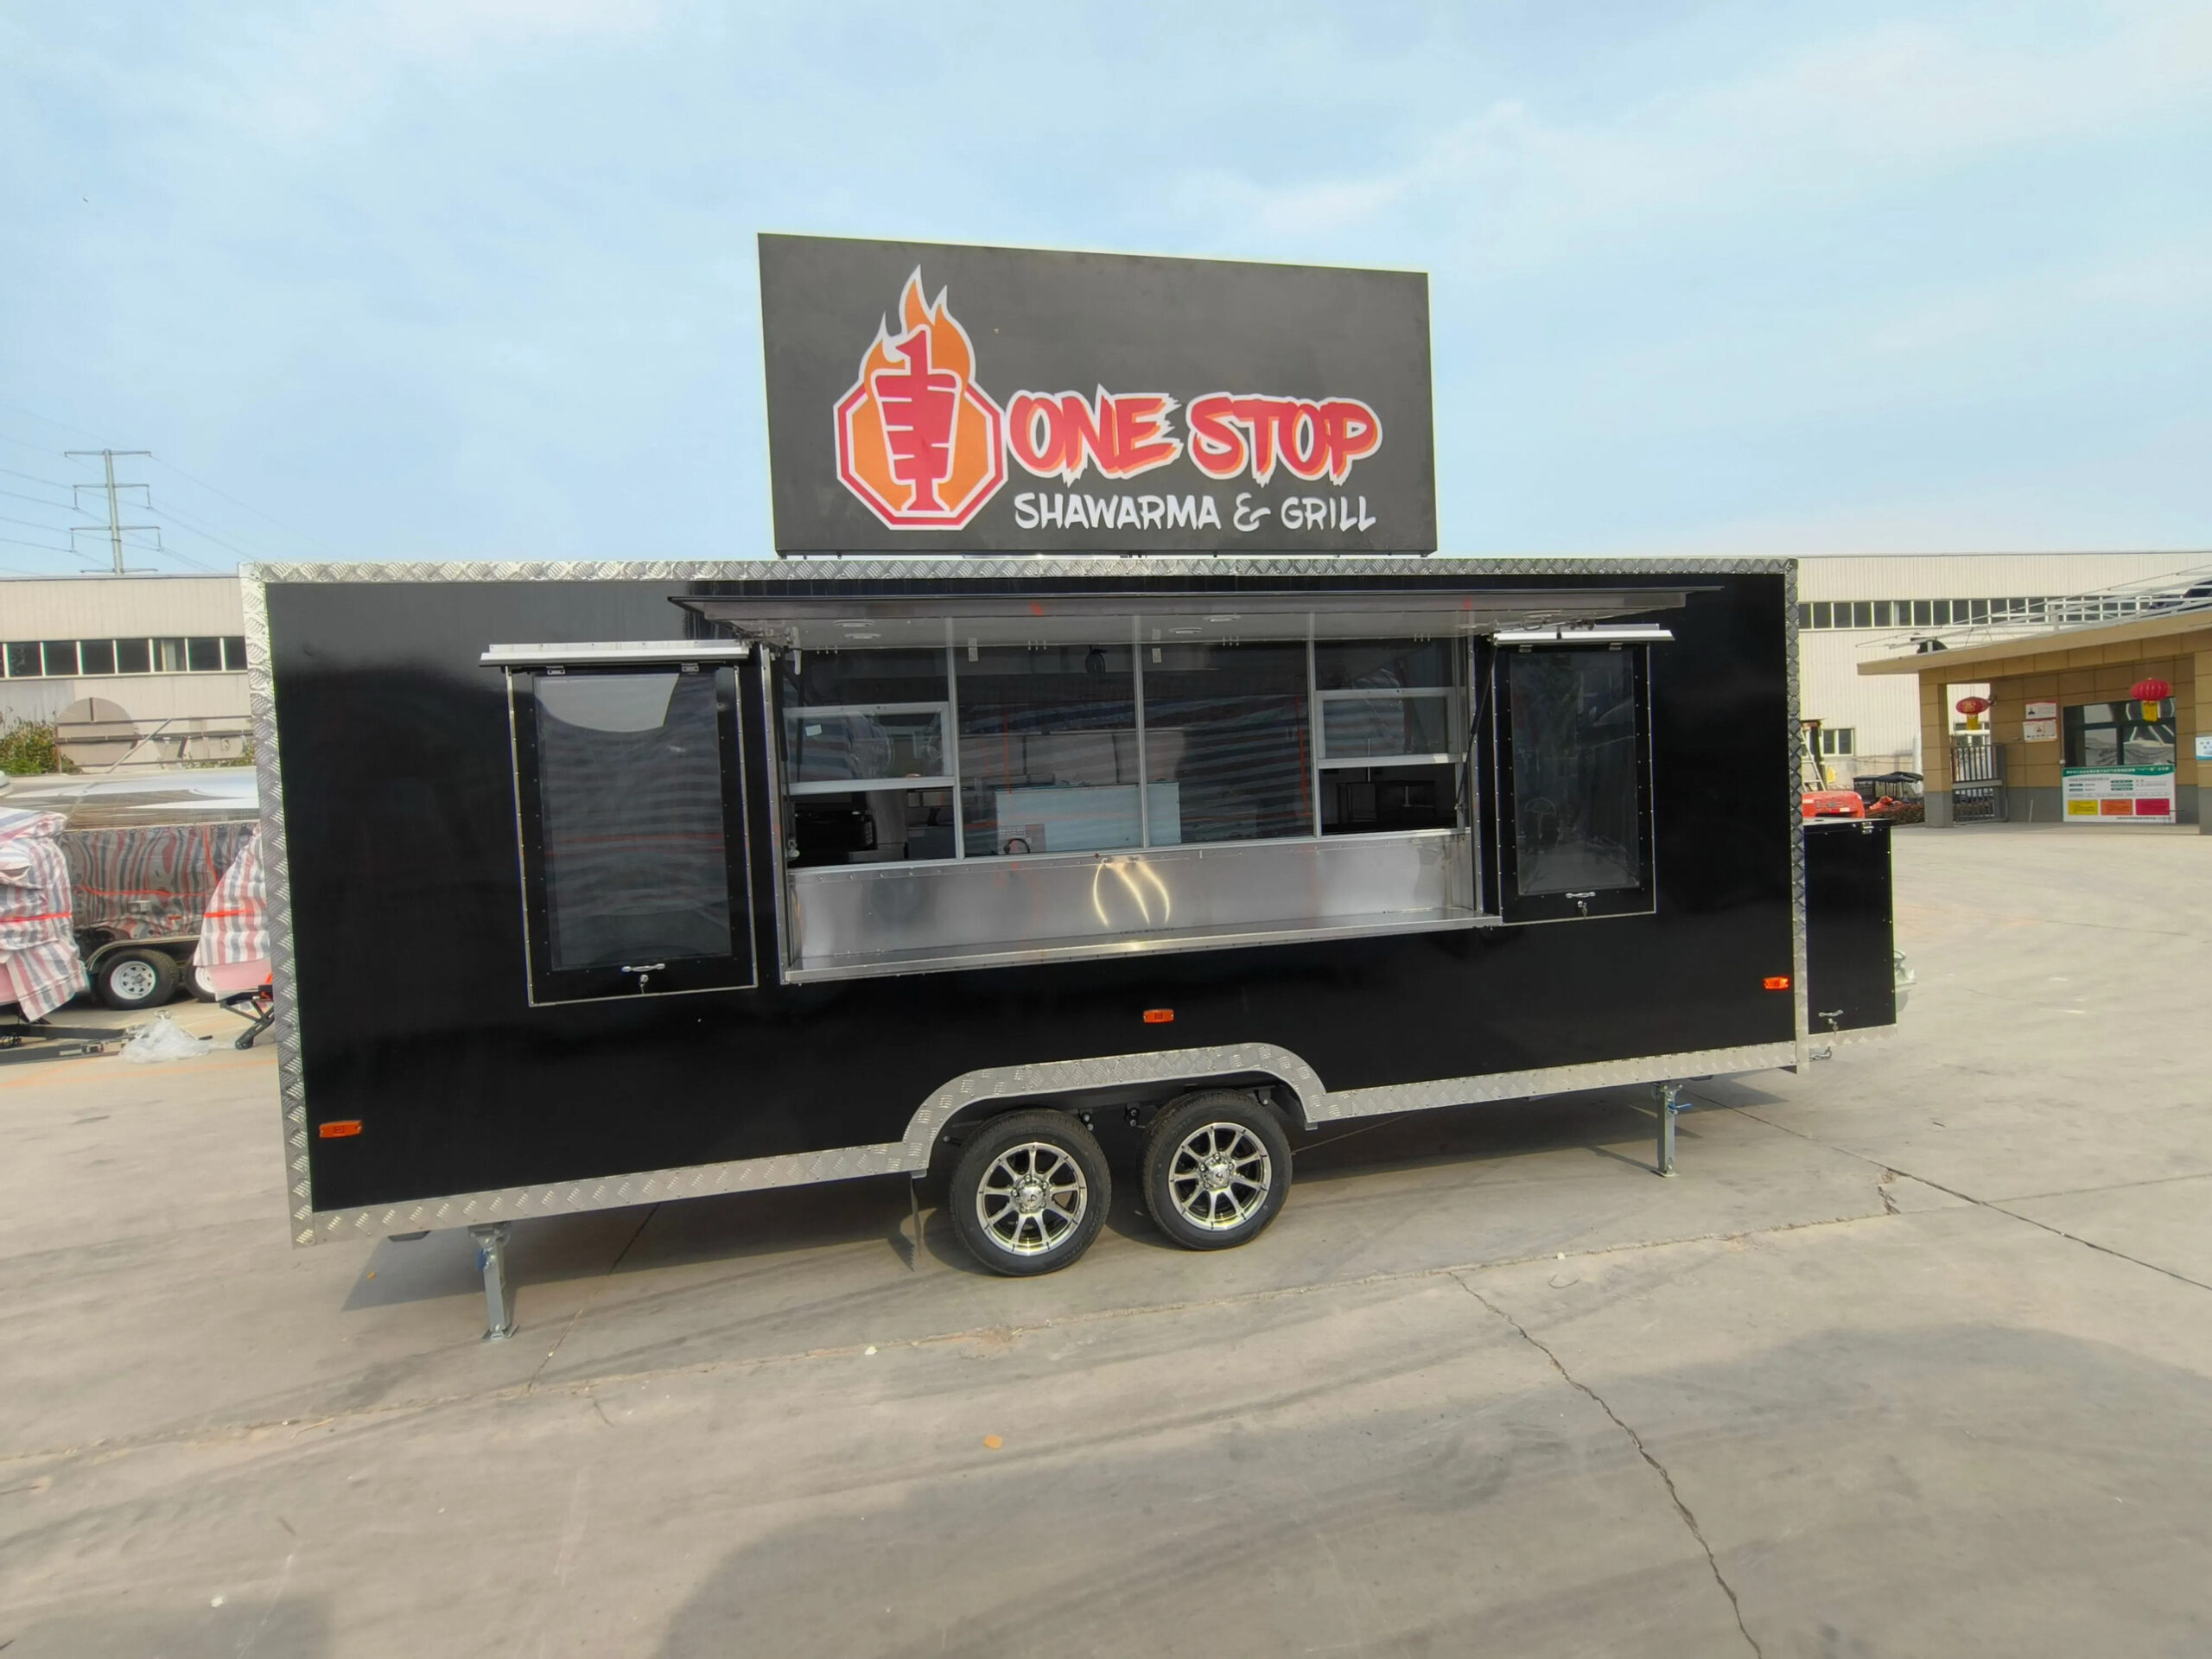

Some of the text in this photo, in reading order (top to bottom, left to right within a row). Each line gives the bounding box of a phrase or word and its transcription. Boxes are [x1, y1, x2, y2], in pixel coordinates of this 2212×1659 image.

[1007, 383, 1382, 488] ONE STOP
[1014, 493, 1376, 532] SHAWARMA & GRILL
